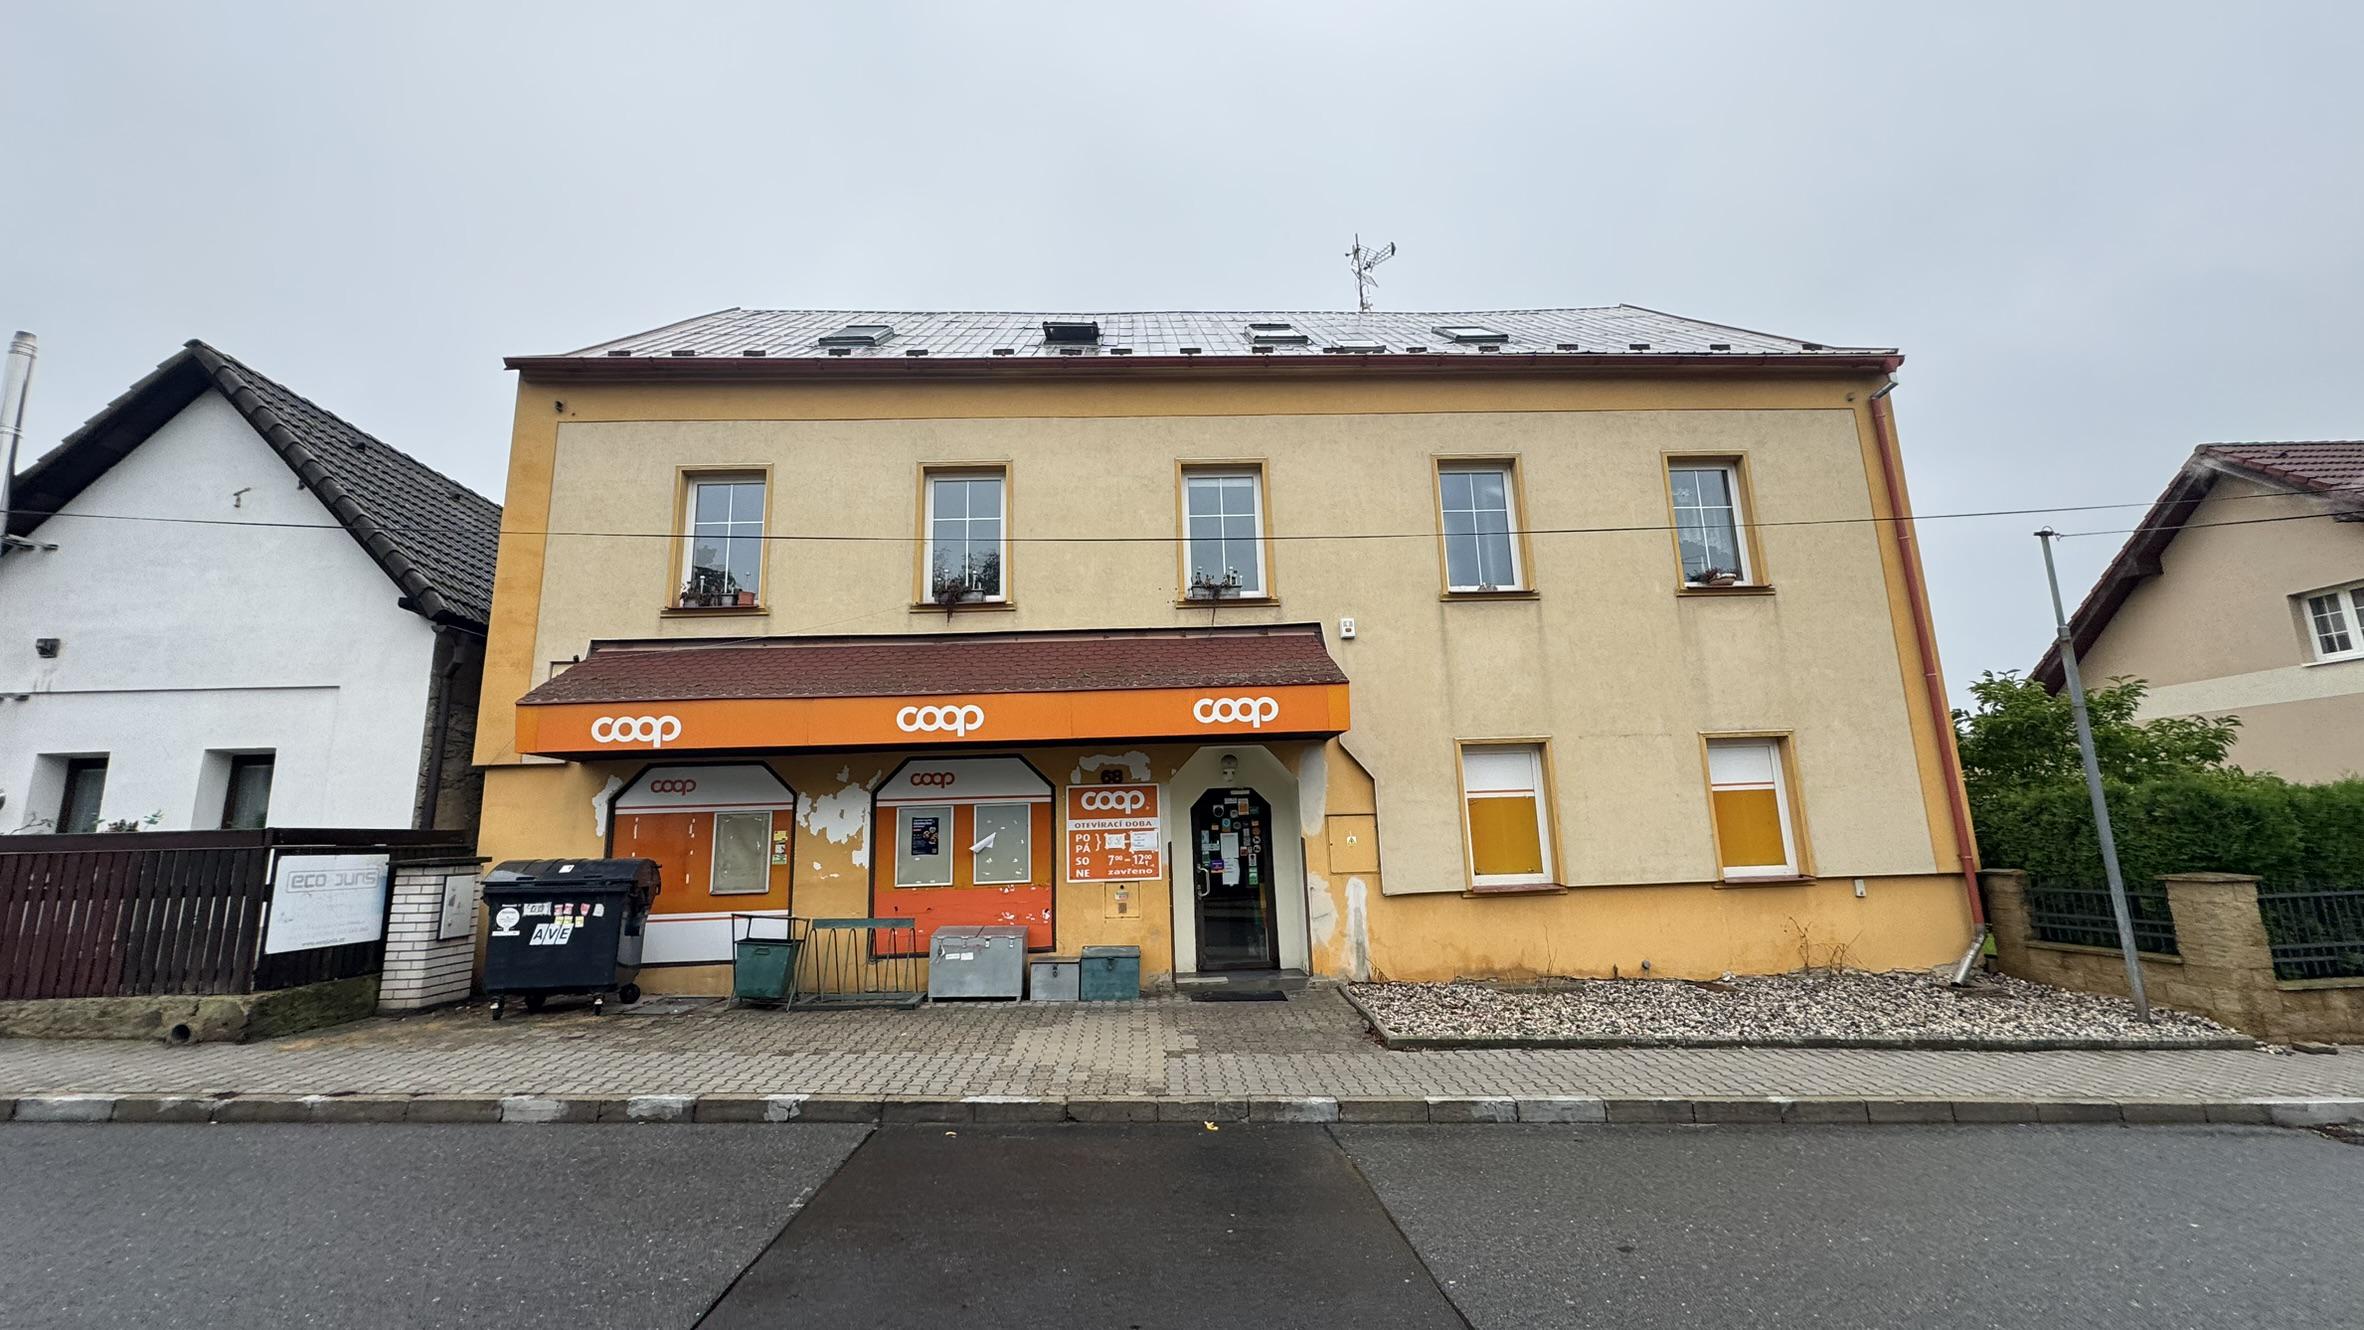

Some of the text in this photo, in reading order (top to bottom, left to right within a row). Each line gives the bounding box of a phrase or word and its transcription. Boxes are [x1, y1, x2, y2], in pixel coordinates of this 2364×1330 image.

[1192, 696, 1279, 729] coop
[896, 704, 985, 737] coop
[591, 715, 682, 748] coop
[910, 771, 955, 789] coop
[1101, 769, 1123, 784] 68
[650, 779, 697, 796] coop
[1081, 790, 1145, 814] coop
[1074, 820, 1122, 829] OTEVÍRACÍ
[1075, 834, 1090, 842] PO
[1075, 843, 1091, 853] PÁ
[1075, 857, 1090, 866] SO
[291, 873, 327, 889] eco
[1075, 869, 1090, 878] NE
[533, 927, 570, 940] AVE
